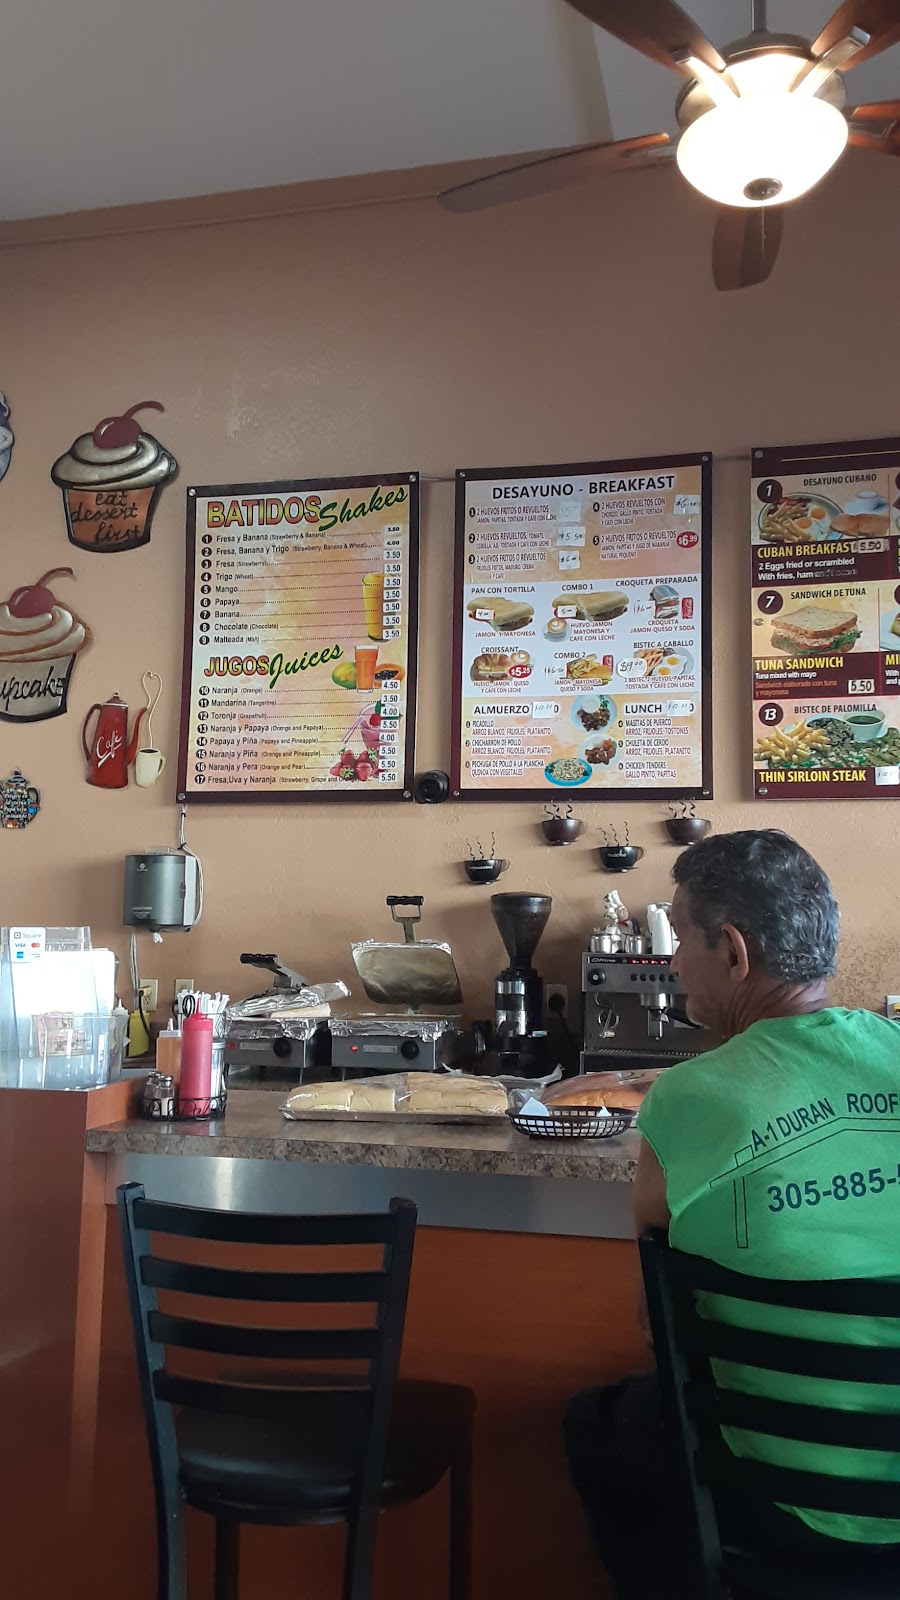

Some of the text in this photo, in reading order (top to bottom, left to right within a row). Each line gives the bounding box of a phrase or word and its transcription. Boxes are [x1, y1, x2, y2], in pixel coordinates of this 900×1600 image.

[804, 474, 876, 486] DESAYUNO CUBANO
[493, 476, 675, 499] DESAYUNO BREAKFAST
[766, 485, 772, 496] 1
[95, 493, 127, 505] eat
[606, 501, 625, 509] HUEVOS
[627, 499, 653, 507] REVUELTOS
[71, 503, 137, 522] dessert
[207, 485, 409, 532] BATIDOS Shakes
[523, 505, 549, 513] REVUELTOS
[94, 523, 140, 544] first
[649, 531, 676, 539] REVUELTOS
[217, 535, 234, 543] Fresa
[239, 546, 264, 554] Banana
[272, 545, 289, 553] Trigo
[758, 542, 857, 558] CUBAN BREAKFAST
[860, 542, 881, 550] 5.50
[386, 551, 400, 559] 3.50
[500, 554, 514, 562] FRITOS
[521, 553, 546, 561] REVUELTOS
[765, 562, 784, 571] Eggs
[815, 558, 854, 566] scrambled
[216, 573, 233, 581] Trigo
[656, 576, 698, 584] PREPARADA
[386, 578, 400, 586] 3.50
[216, 586, 238, 594] Mango
[791, 590, 831, 599] SANDWICH
[846, 588, 866, 596] TUNA
[215, 598, 240, 606] Papaya
[765, 596, 775, 608] 7
[385, 603, 400, 611] 3.50
[214, 623, 248, 631] Chocolate
[385, 630, 400, 638] 3.50
[204, 644, 343, 689] JUGOS Juices
[755, 657, 843, 670] TUNA SANDWICH
[384, 681, 398, 689] 4.50
[851, 681, 871, 691] 5.50
[212, 687, 237, 695] Naranja
[211, 699, 246, 707] Mandarina
[383, 708, 398, 716] 4.00
[474, 705, 529, 714] ALMUERZO
[626, 705, 662, 713] LUNCH
[834, 704, 876, 712] PALOMILLA
[211, 712, 237, 720] Toronja
[764, 709, 776, 720] 13
[210, 725, 237, 733] Naranja
[245, 724, 269, 732] Papaya
[383, 721, 397, 729] 5.50
[210, 738, 234, 746] Papaya
[243, 737, 257, 745] Piña
[381, 734, 395, 742] 4.00
[209, 750, 235, 759] Naranja
[243, 750, 258, 758] Piña
[381, 747, 396, 755] 5.50
[209, 764, 235, 772] Naranja
[243, 763, 258, 771] Pera
[250, 776, 276, 784] Naranja
[381, 774, 396, 782] 5.50
[760, 771, 786, 782] THIN
[788, 770, 831, 782] SIRLOIN
[833, 770, 866, 781] STEAK
[751, 1122, 778, 1151] A-1
[776, 1098, 836, 1137] DURAN
